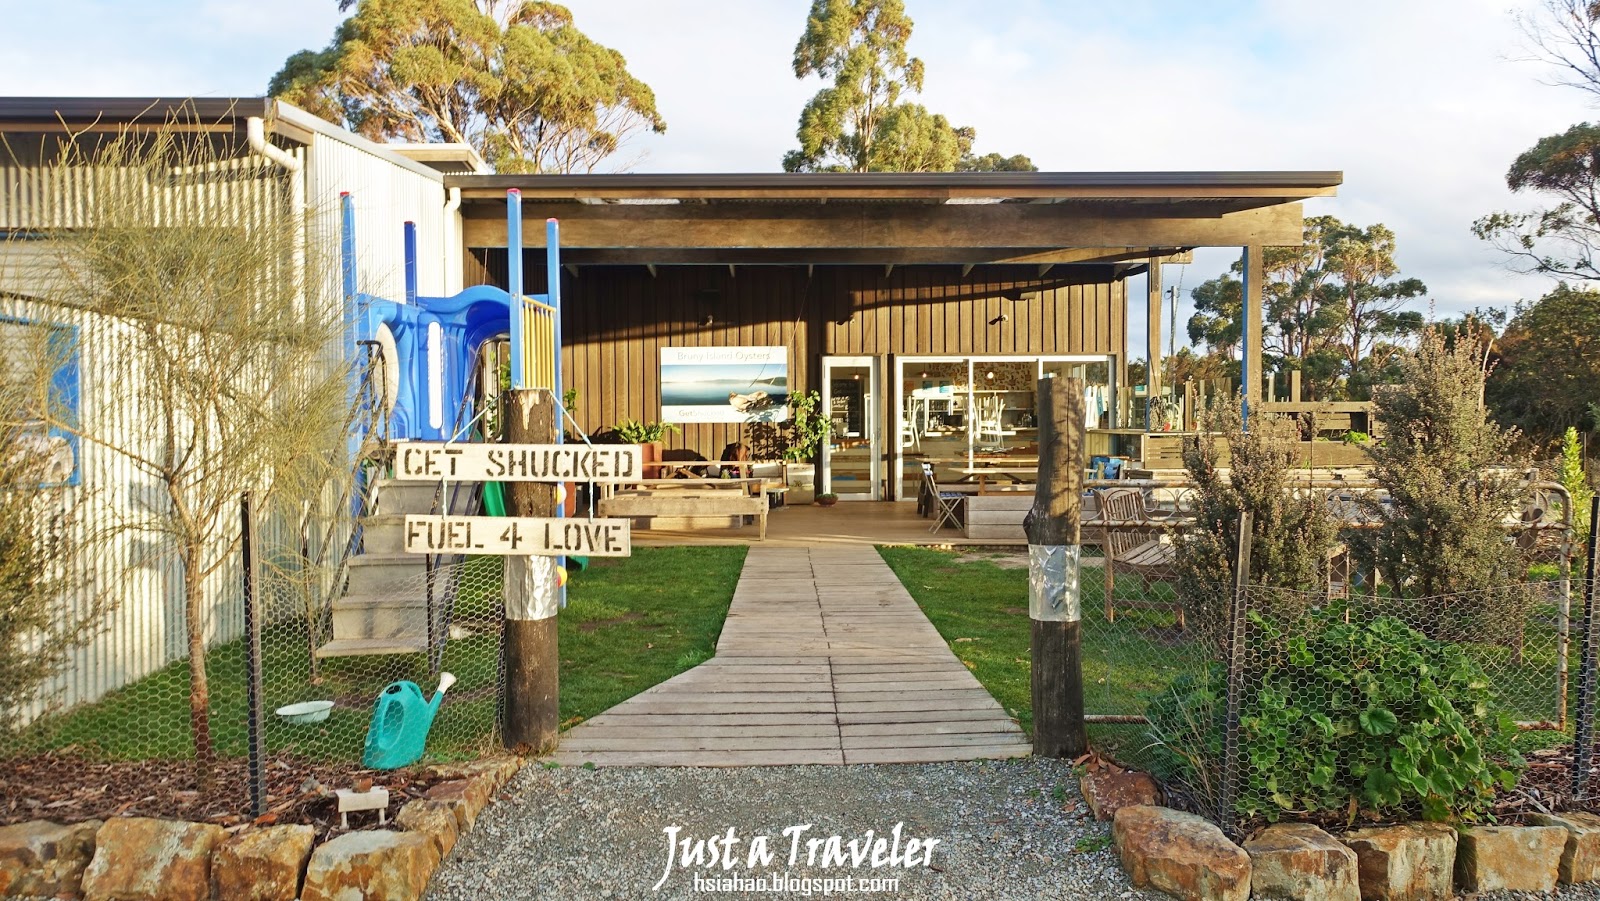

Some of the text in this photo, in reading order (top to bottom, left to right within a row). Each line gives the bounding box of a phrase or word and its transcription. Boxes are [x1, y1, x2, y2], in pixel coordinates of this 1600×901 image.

[677, 351, 770, 362] Bruny Island Oysters
[403, 448, 634, 478] GET SHUCKED
[407, 520, 622, 552] FUEL 4 LOVE
